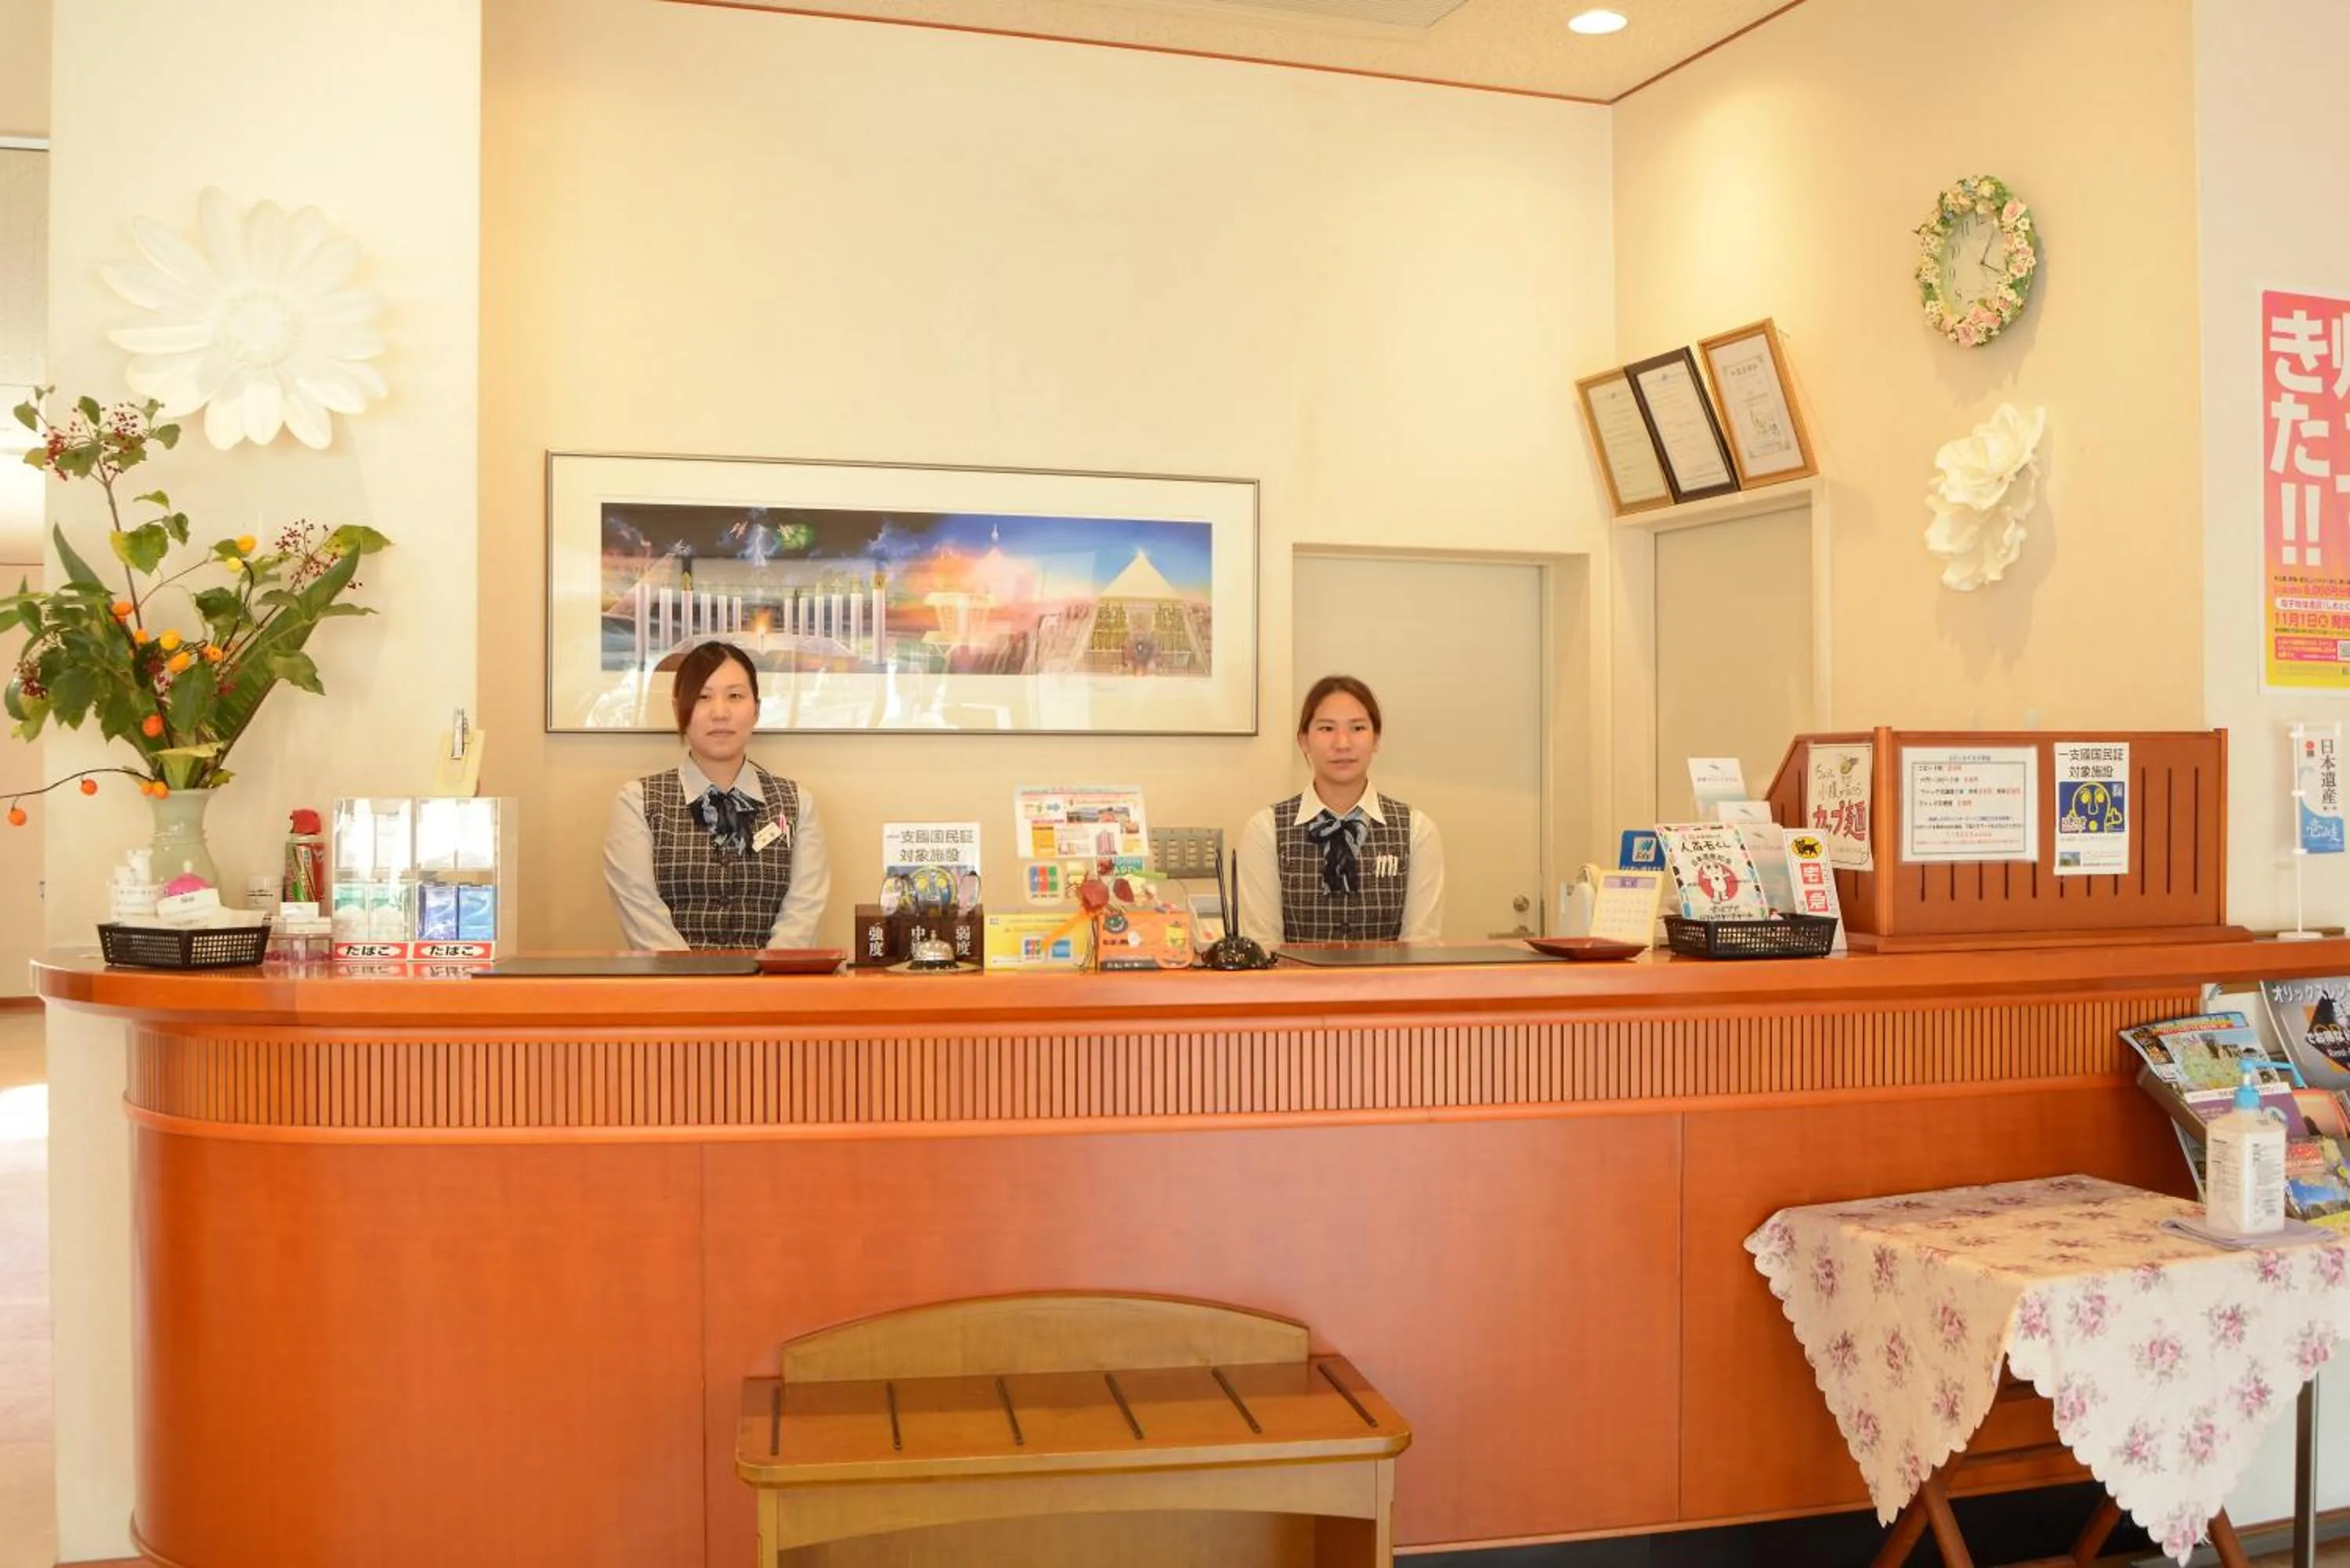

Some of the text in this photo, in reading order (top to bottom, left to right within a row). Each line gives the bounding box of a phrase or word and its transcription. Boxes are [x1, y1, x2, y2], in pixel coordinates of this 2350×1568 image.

[2069, 765, 2113, 779] 対象施設
[2320, 739, 2337, 804] 日本遺産
[899, 848, 960, 862] 対象施設
[868, 925, 885, 957] 強度
[345, 945, 390, 956] たばこ
[430, 945, 474, 956] たばこ
[2272, 981, 2350, 1003] オリックスレン
